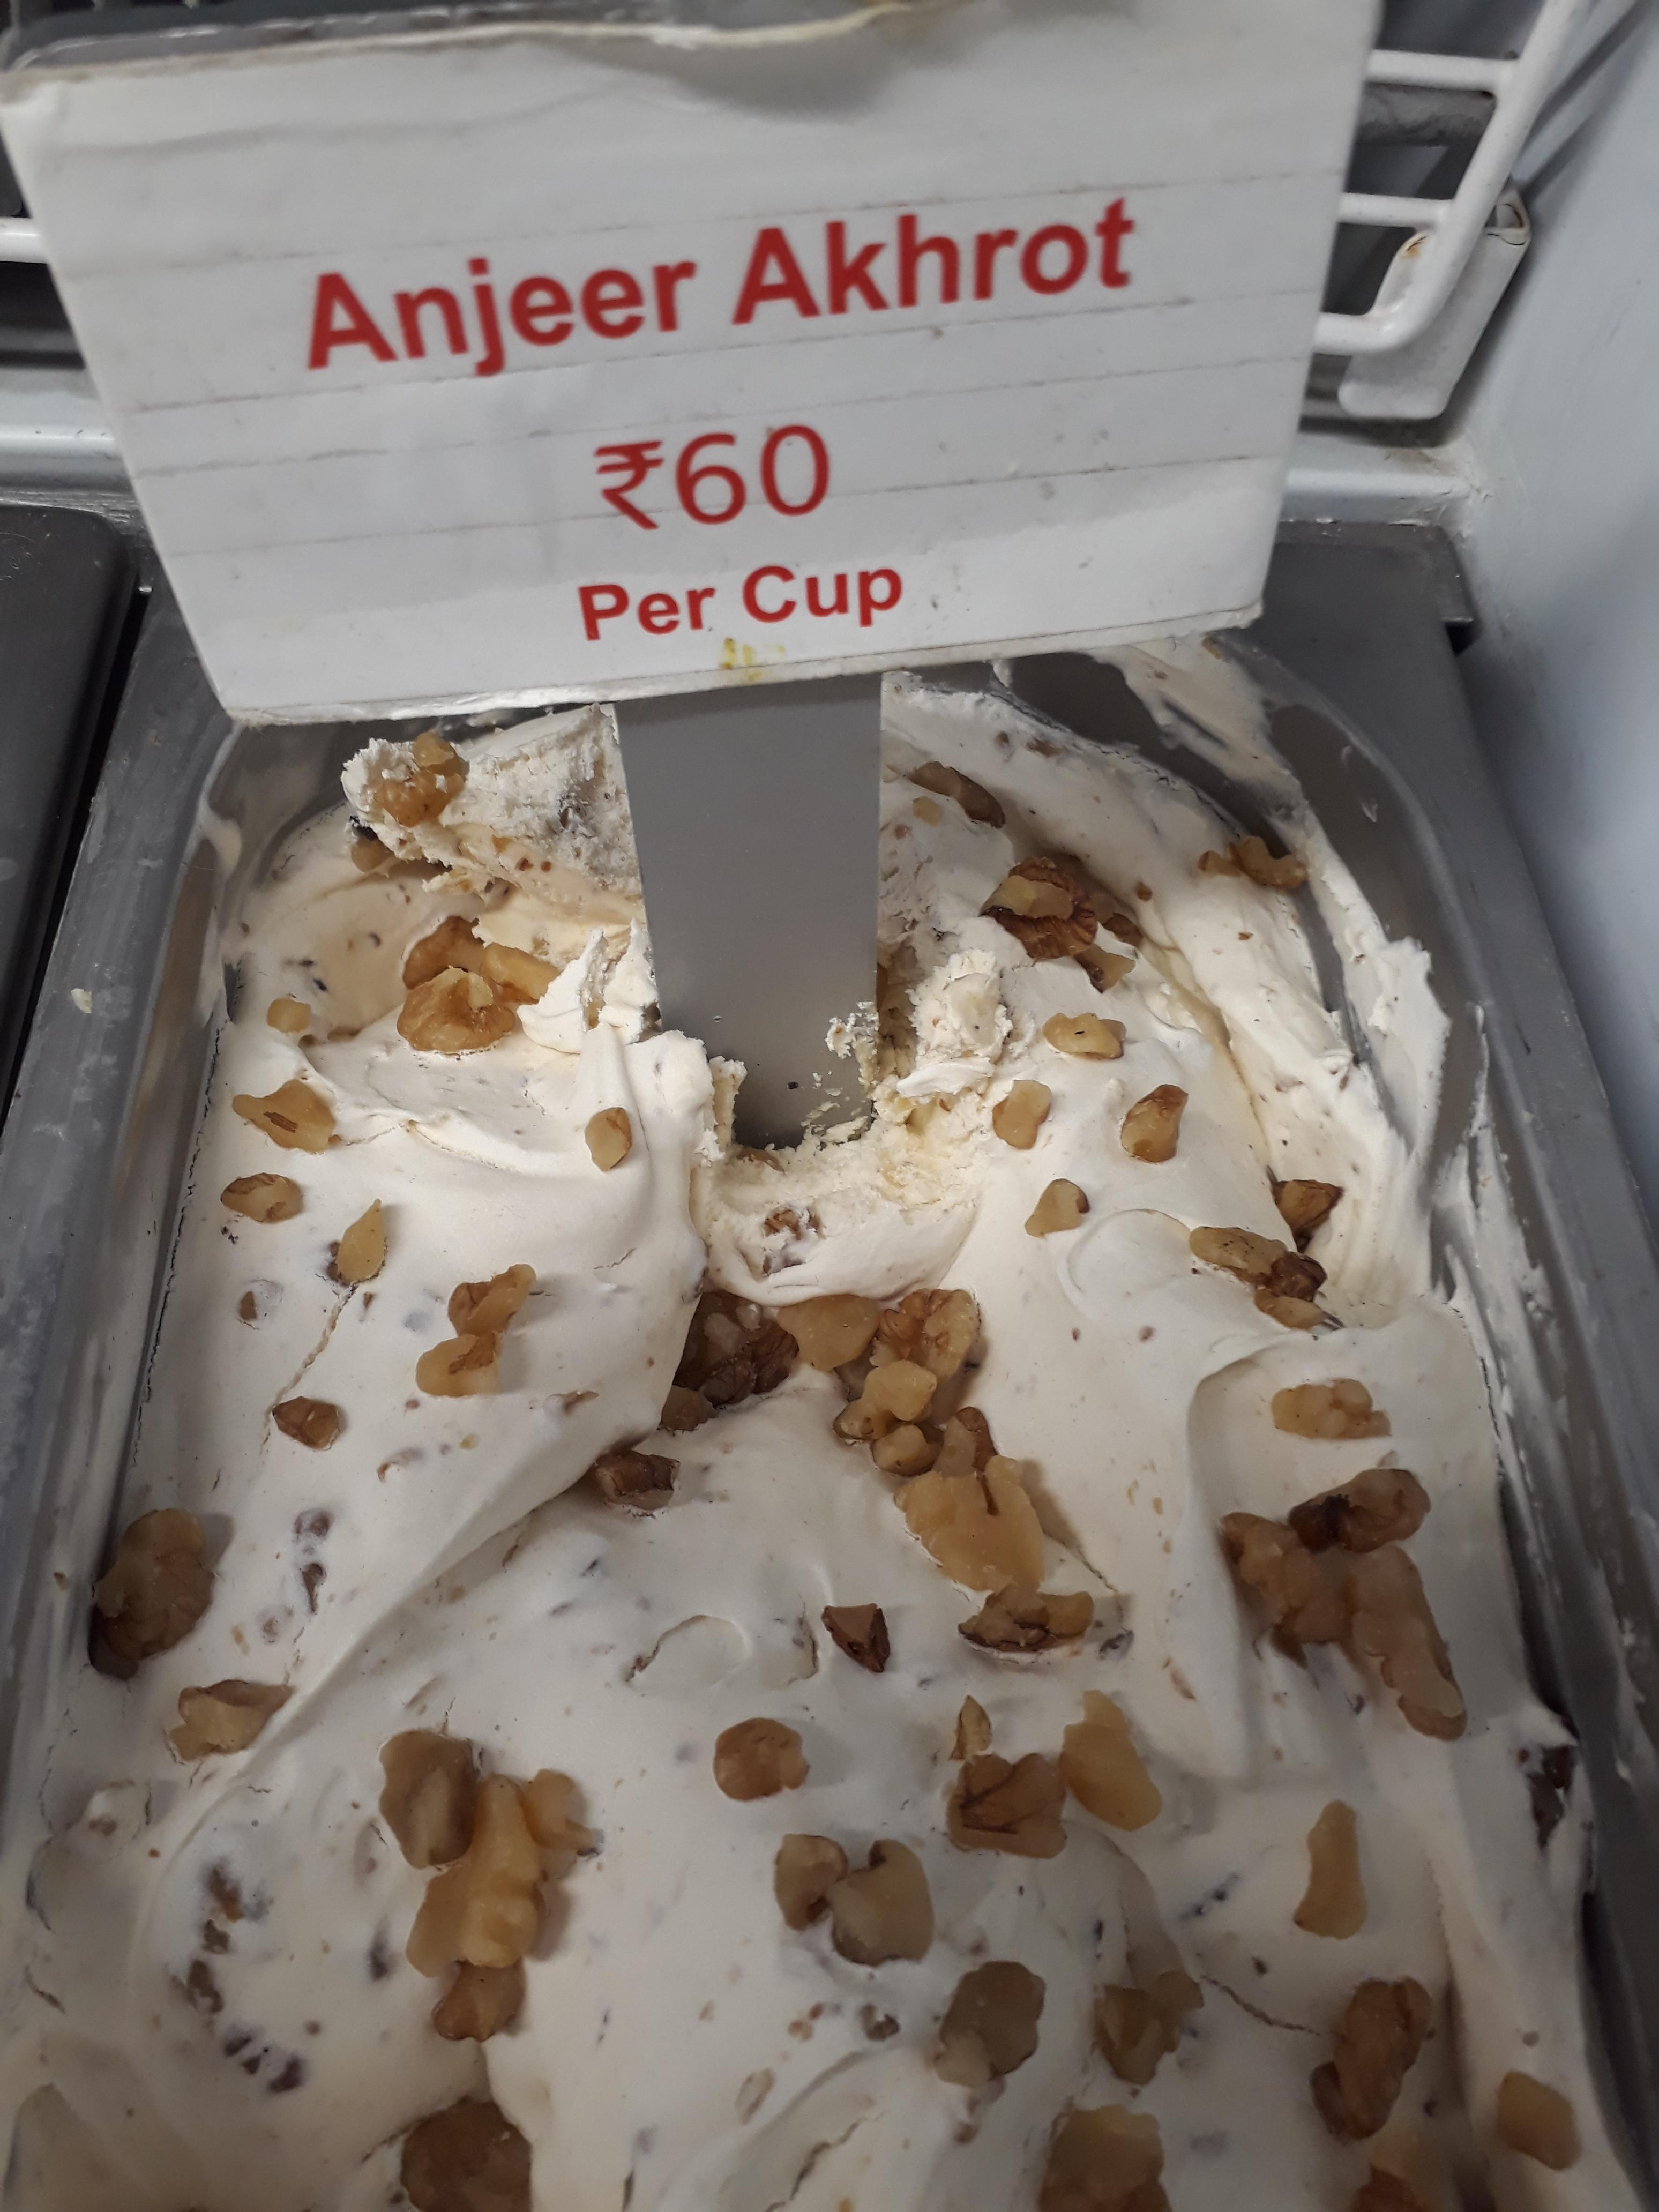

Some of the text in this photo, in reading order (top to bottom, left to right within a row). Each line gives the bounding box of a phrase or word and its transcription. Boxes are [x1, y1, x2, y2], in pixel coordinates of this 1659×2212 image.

[308, 199, 1134, 376] Anjeer Akhrot
[595, 424, 830, 530] ₹60
[578, 565, 903, 641] Per Cup
